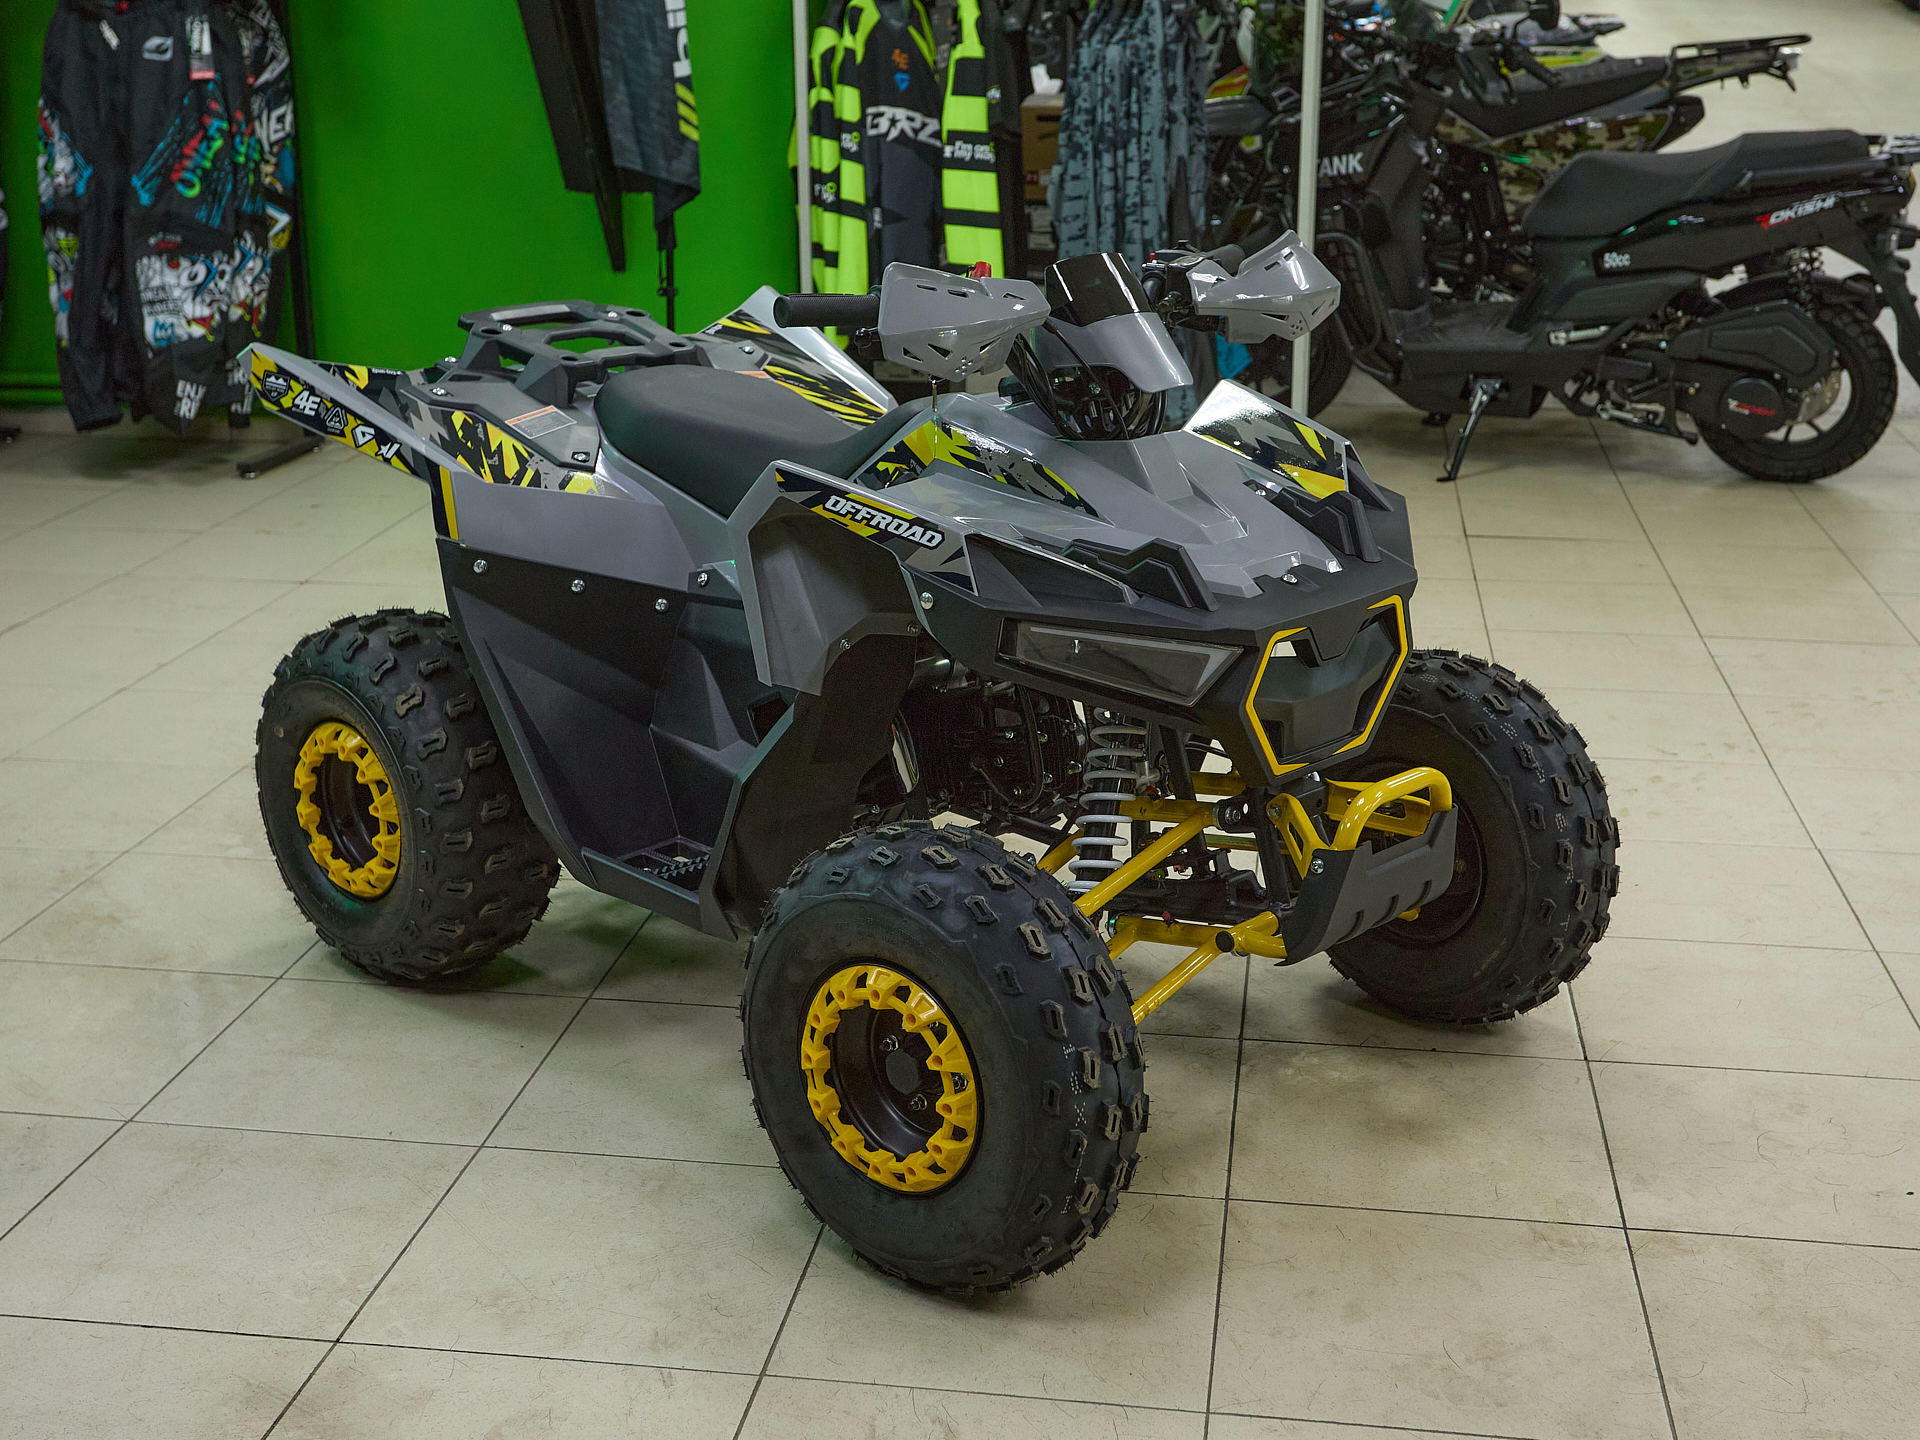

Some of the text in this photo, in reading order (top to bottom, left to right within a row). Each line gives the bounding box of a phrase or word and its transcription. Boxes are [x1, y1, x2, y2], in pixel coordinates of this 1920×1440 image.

[1317, 152, 1364, 178] ANK
[293, 390, 321, 417] 4E
[824, 495, 943, 547] OFFROAD
